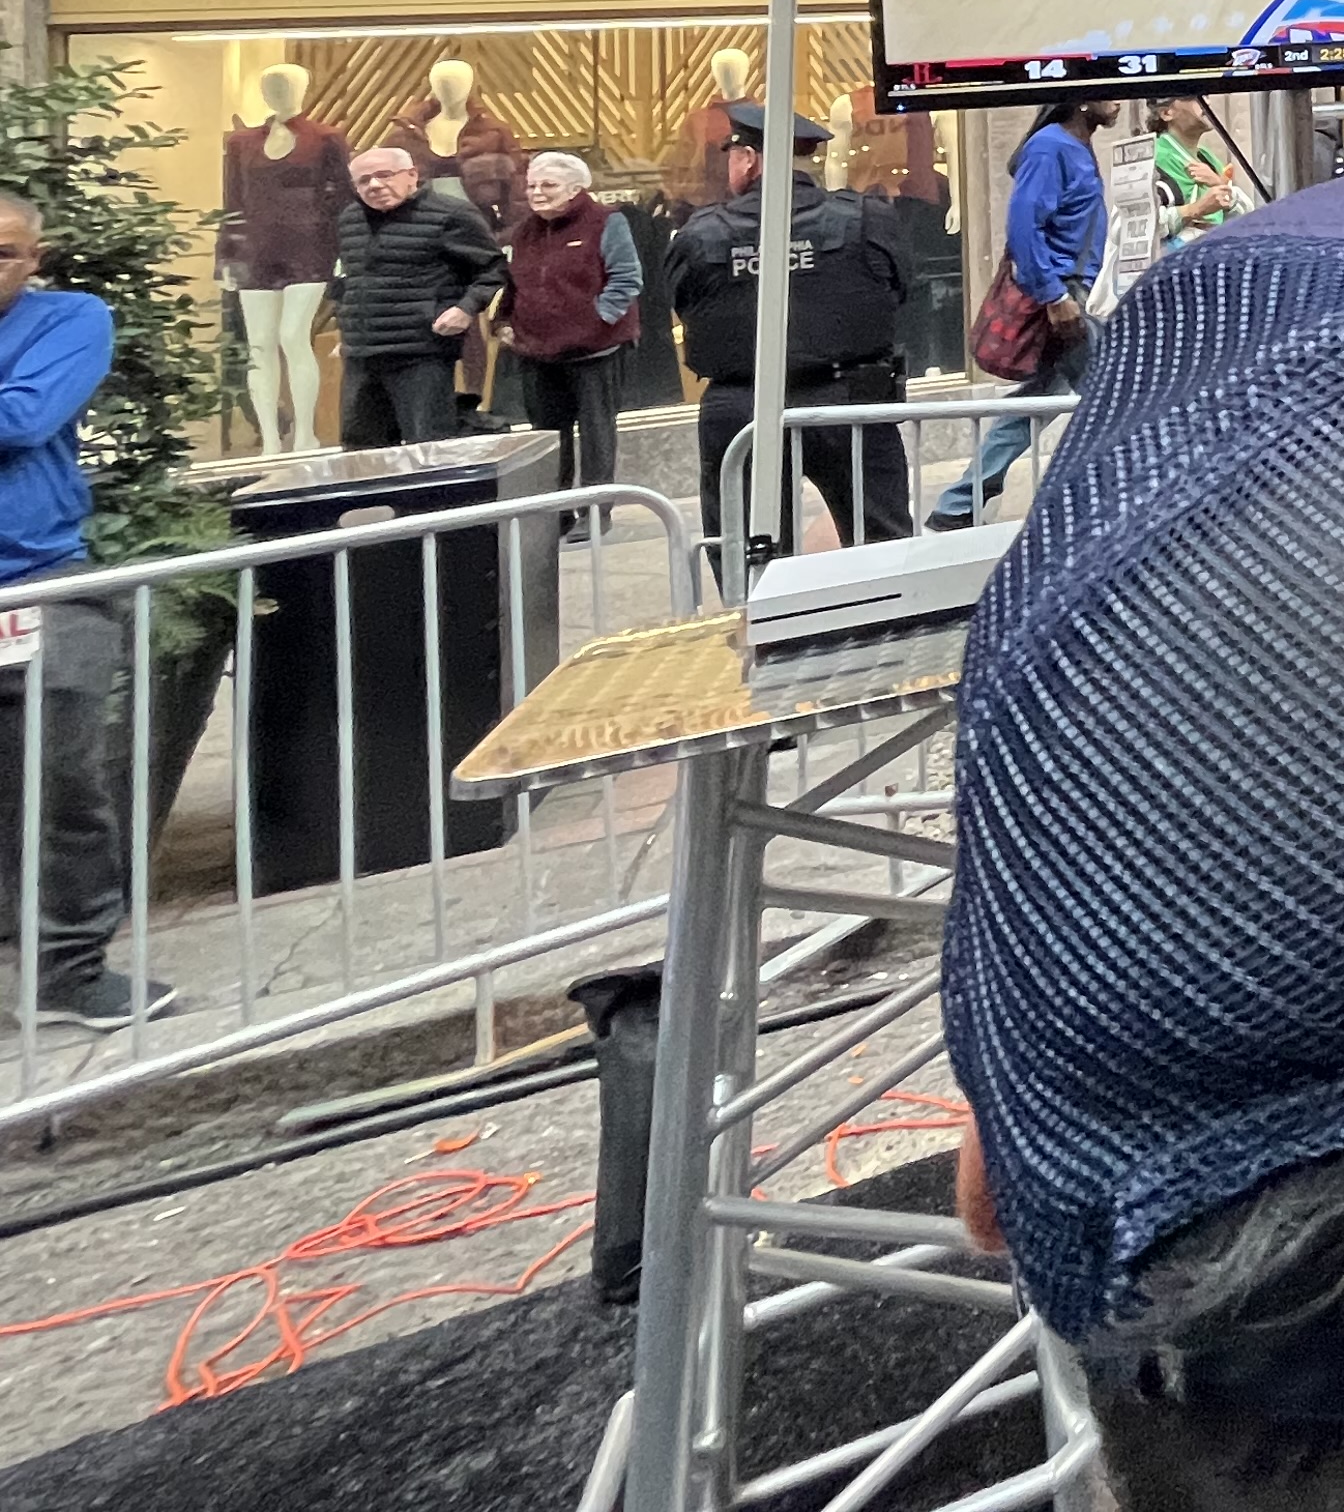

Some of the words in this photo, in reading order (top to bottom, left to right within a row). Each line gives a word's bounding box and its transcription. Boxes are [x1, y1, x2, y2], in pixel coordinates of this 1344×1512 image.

[1024, 59, 1068, 80] 14
[1117, 54, 1159, 75] 31
[1284, 49, 1309, 62] 2nd
[732, 250, 815, 277] POCE
